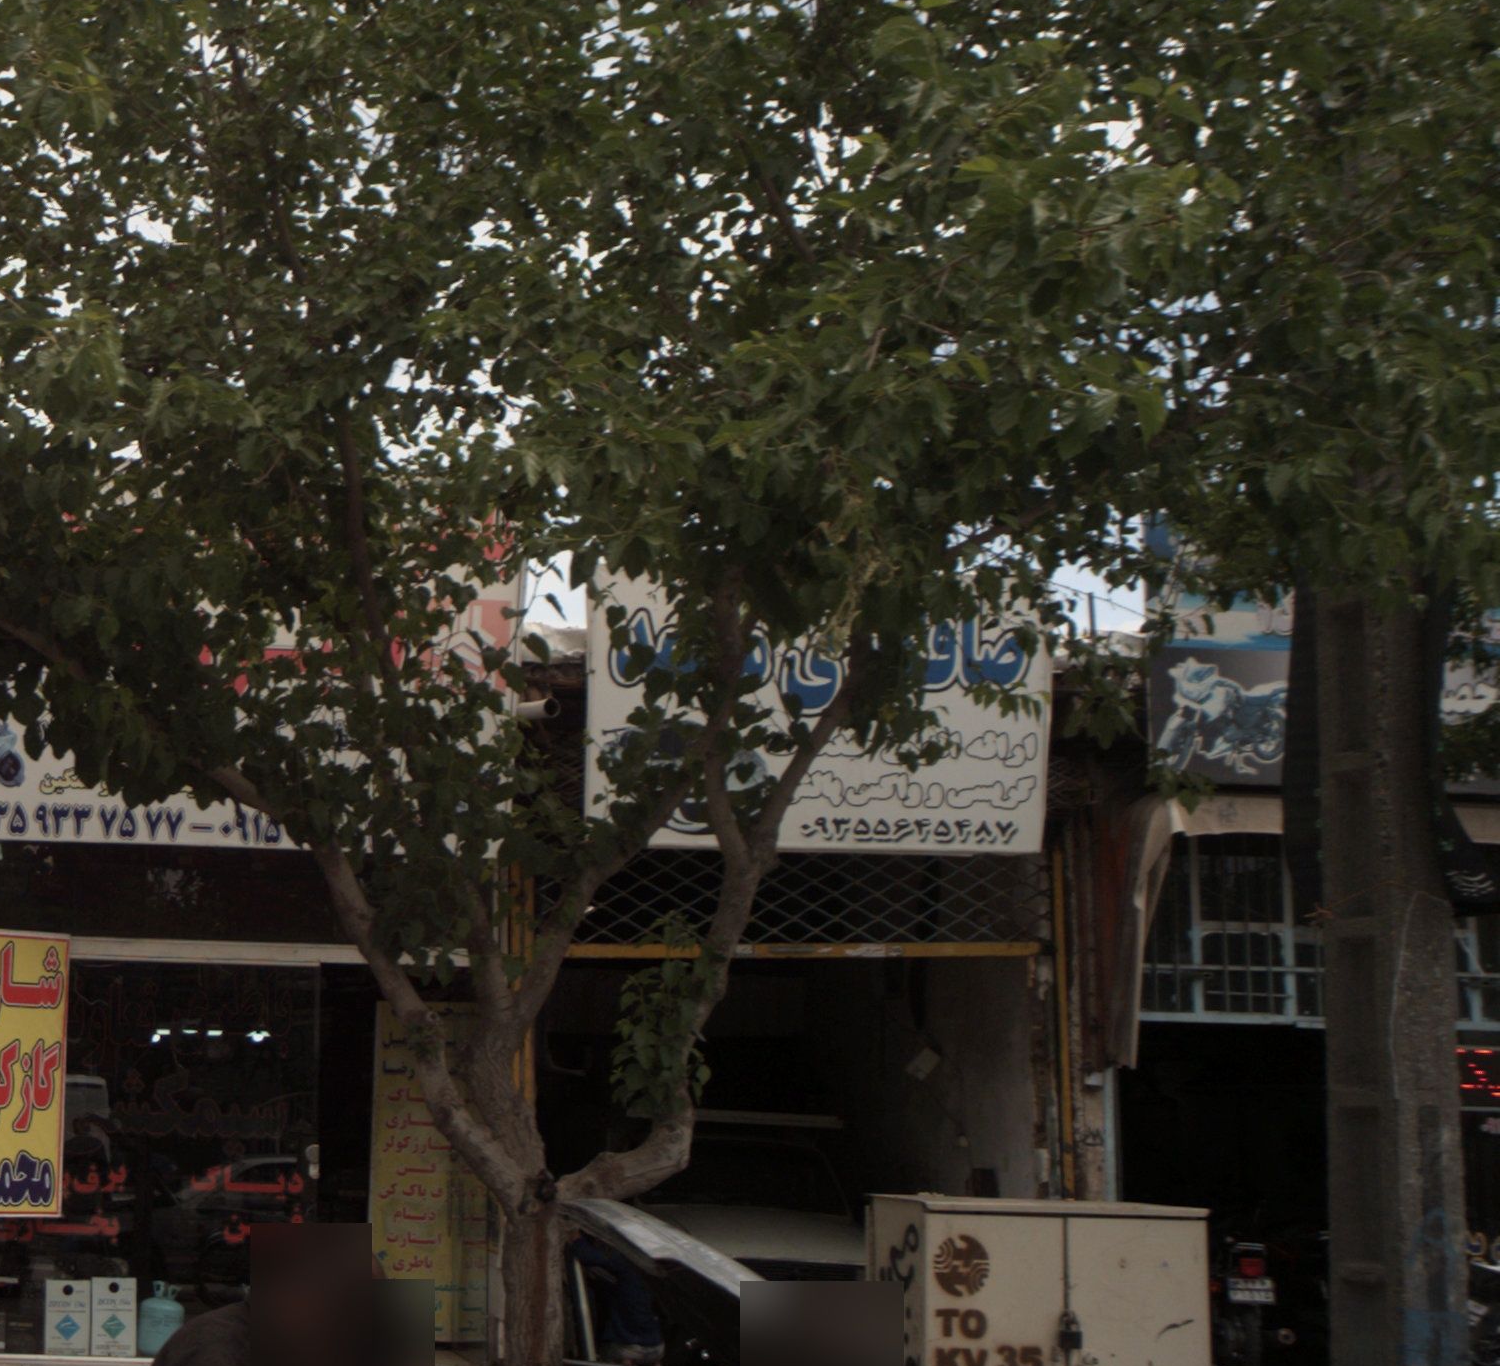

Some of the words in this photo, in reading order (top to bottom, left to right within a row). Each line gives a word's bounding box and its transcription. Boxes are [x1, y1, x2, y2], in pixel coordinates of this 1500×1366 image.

[800, 816, 1019, 846] ۰۹۳۵۵۶۴۵۴۸۷
[12, 1039, 62, 1133] گاز
[935, 1308, 987, 1339] TO
